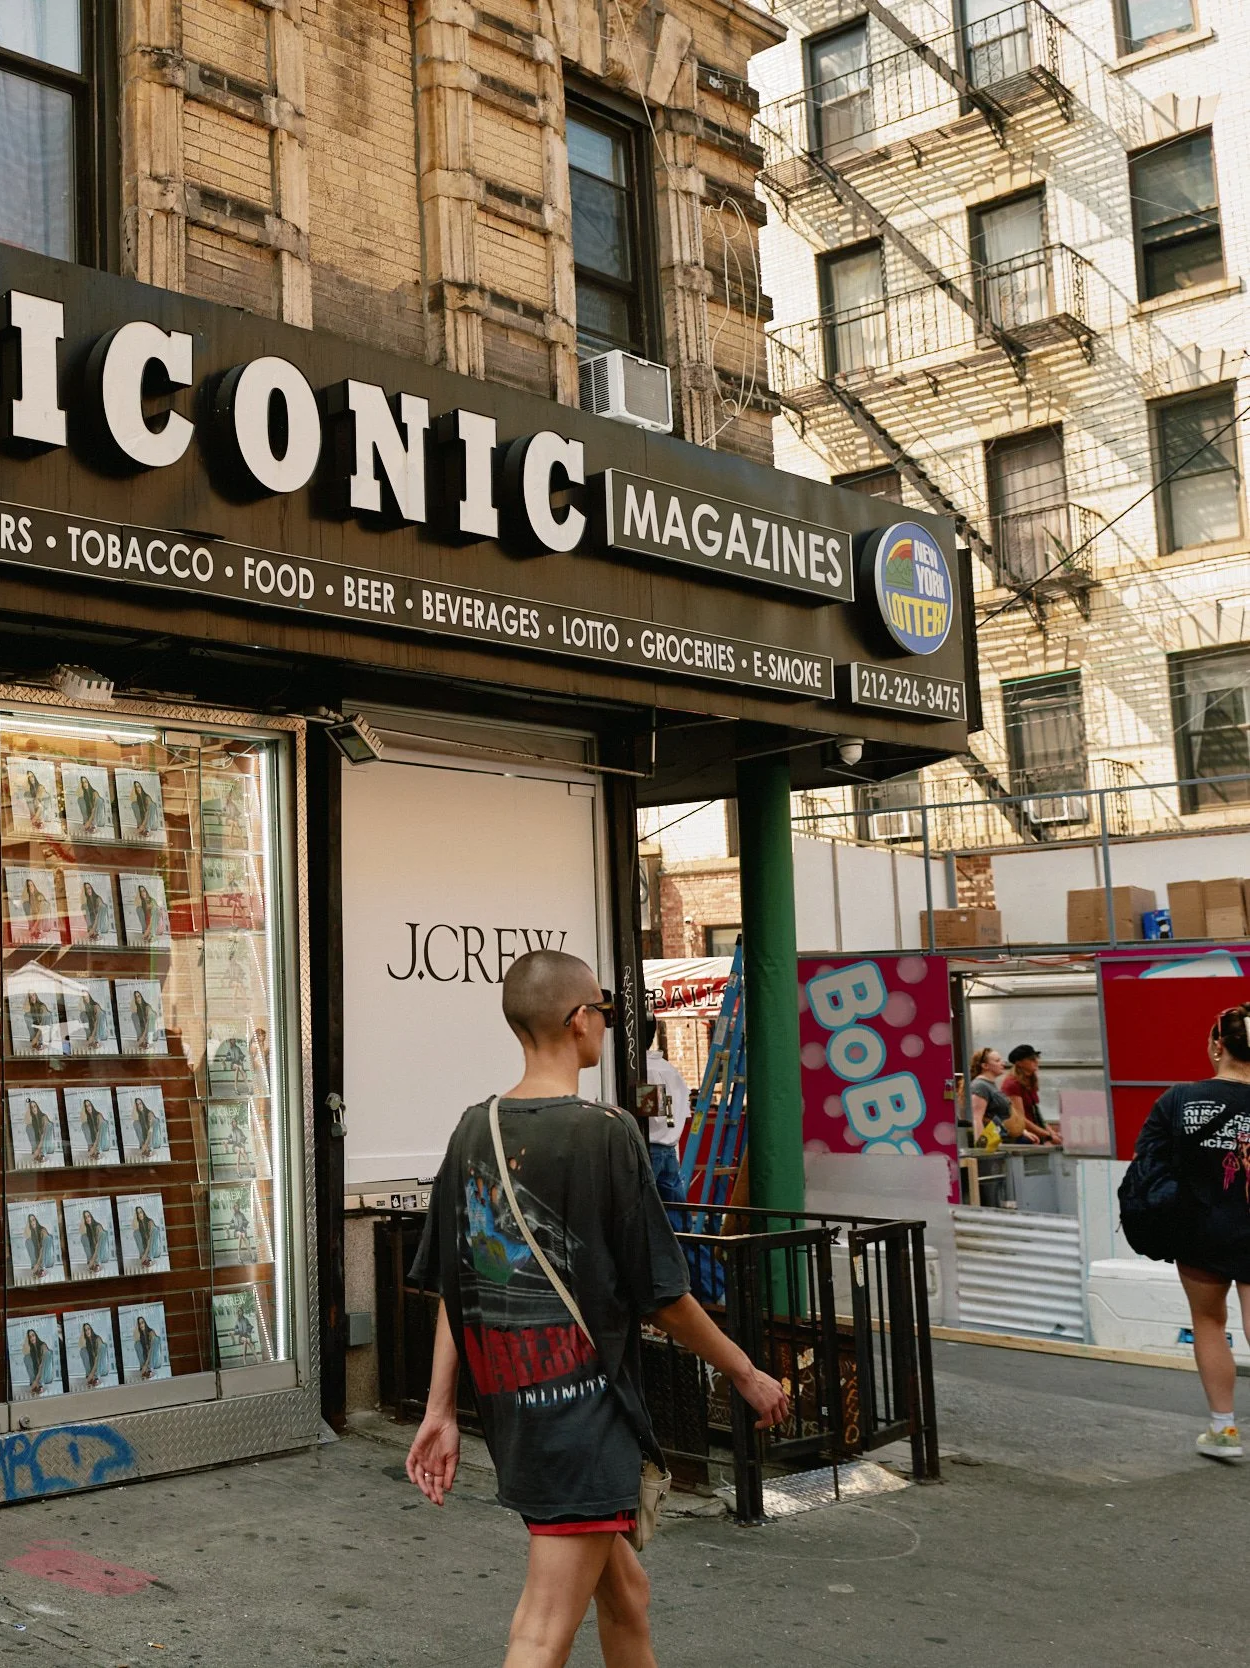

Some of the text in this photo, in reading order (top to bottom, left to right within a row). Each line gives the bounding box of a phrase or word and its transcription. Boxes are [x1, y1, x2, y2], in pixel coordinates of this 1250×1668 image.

[11, 289, 587, 552] ICONIC
[623, 484, 844, 588] MAGAZINES
[914, 540, 938, 570] NEW
[915, 564, 946, 599] YORK
[68, 526, 213, 582] TOBACCO
[244, 557, 315, 601] FOOD
[344, 575, 395, 614] BEER
[422, 589, 540, 639] BEVERAGES
[562, 616, 619, 653] LOTTO
[640, 630, 735, 673] GROCERIES
[753, 651, 822, 689] E-SMOKE
[886, 591, 948, 637] LOTTERY
[861, 670, 960, 713] 212-226-3475
